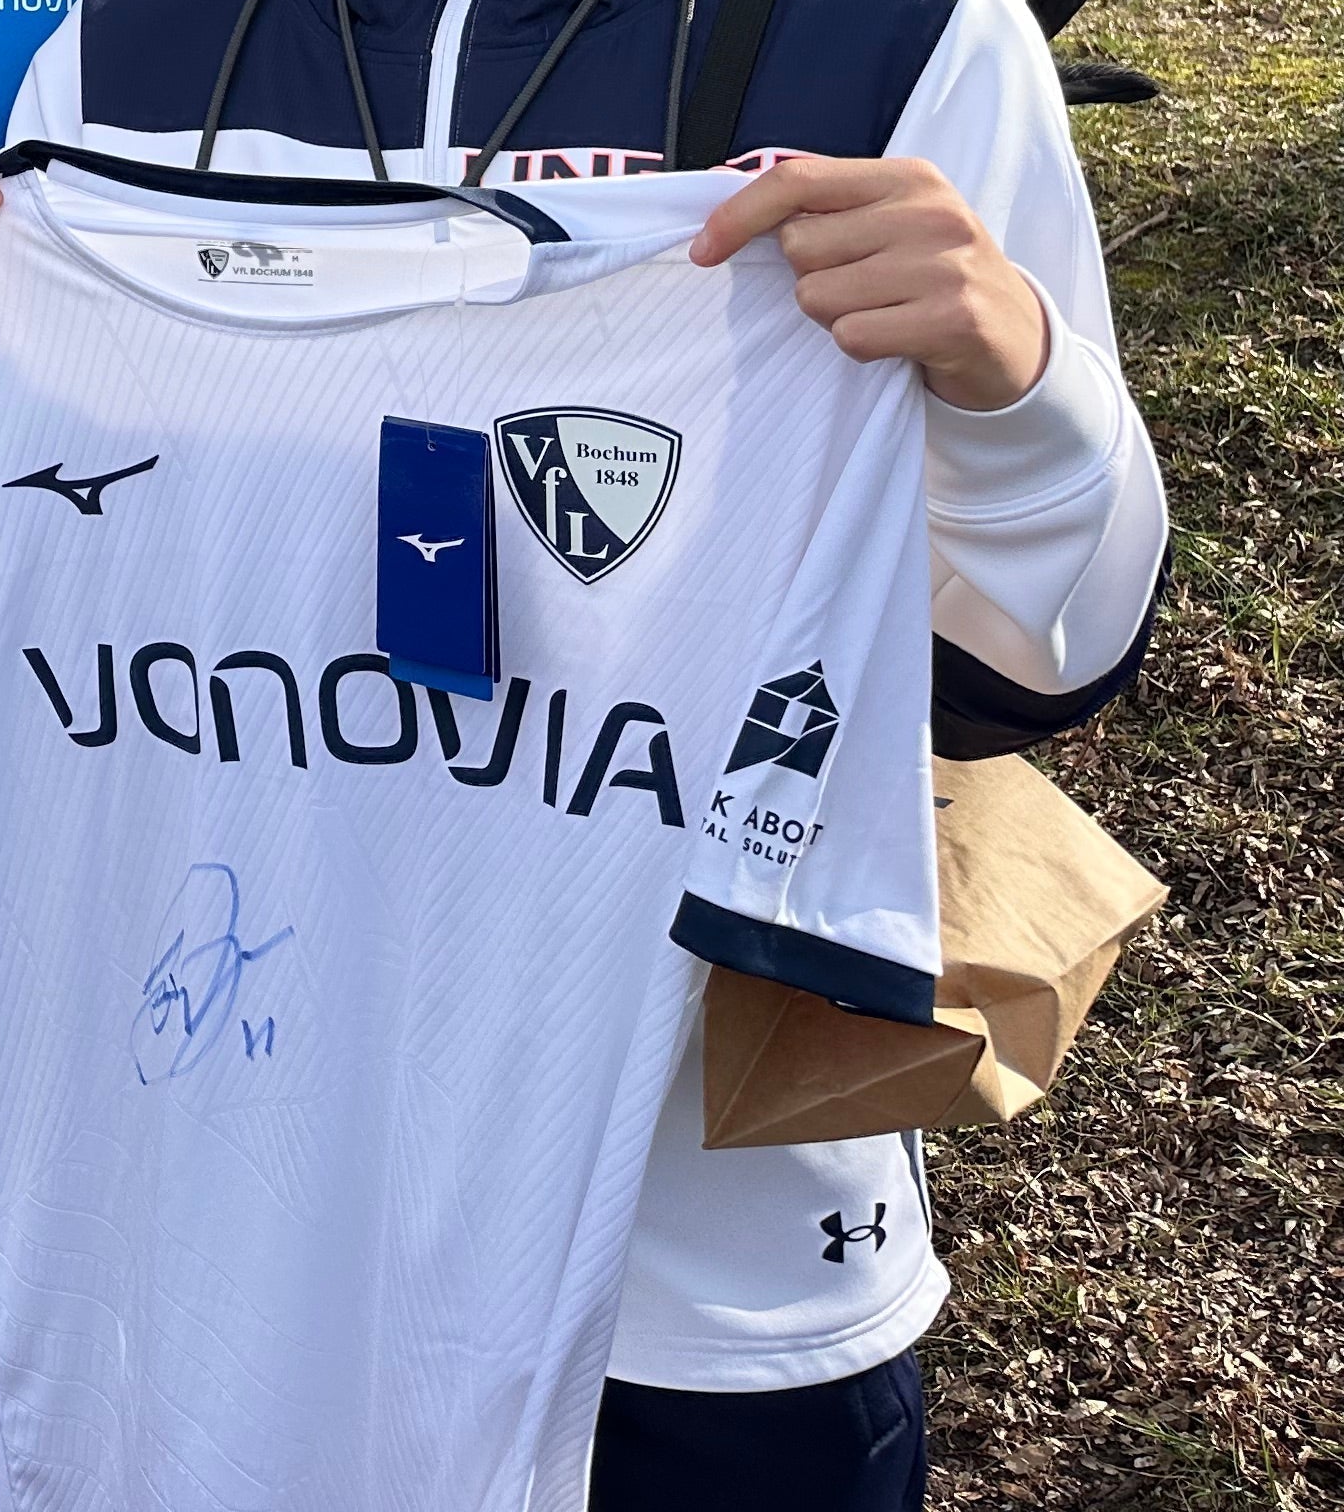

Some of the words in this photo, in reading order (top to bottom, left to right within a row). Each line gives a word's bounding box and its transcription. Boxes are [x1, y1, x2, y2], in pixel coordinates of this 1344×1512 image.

[250, 267, 291, 277] BOCHUM
[292, 268, 314, 278] 1848
[575, 442, 658, 464] Bochum
[594, 468, 639, 487] 1848
[506, 432, 609, 560] VfL
[22, 641, 686, 828] VONOVIA
[742, 805, 824, 846] ABOT
